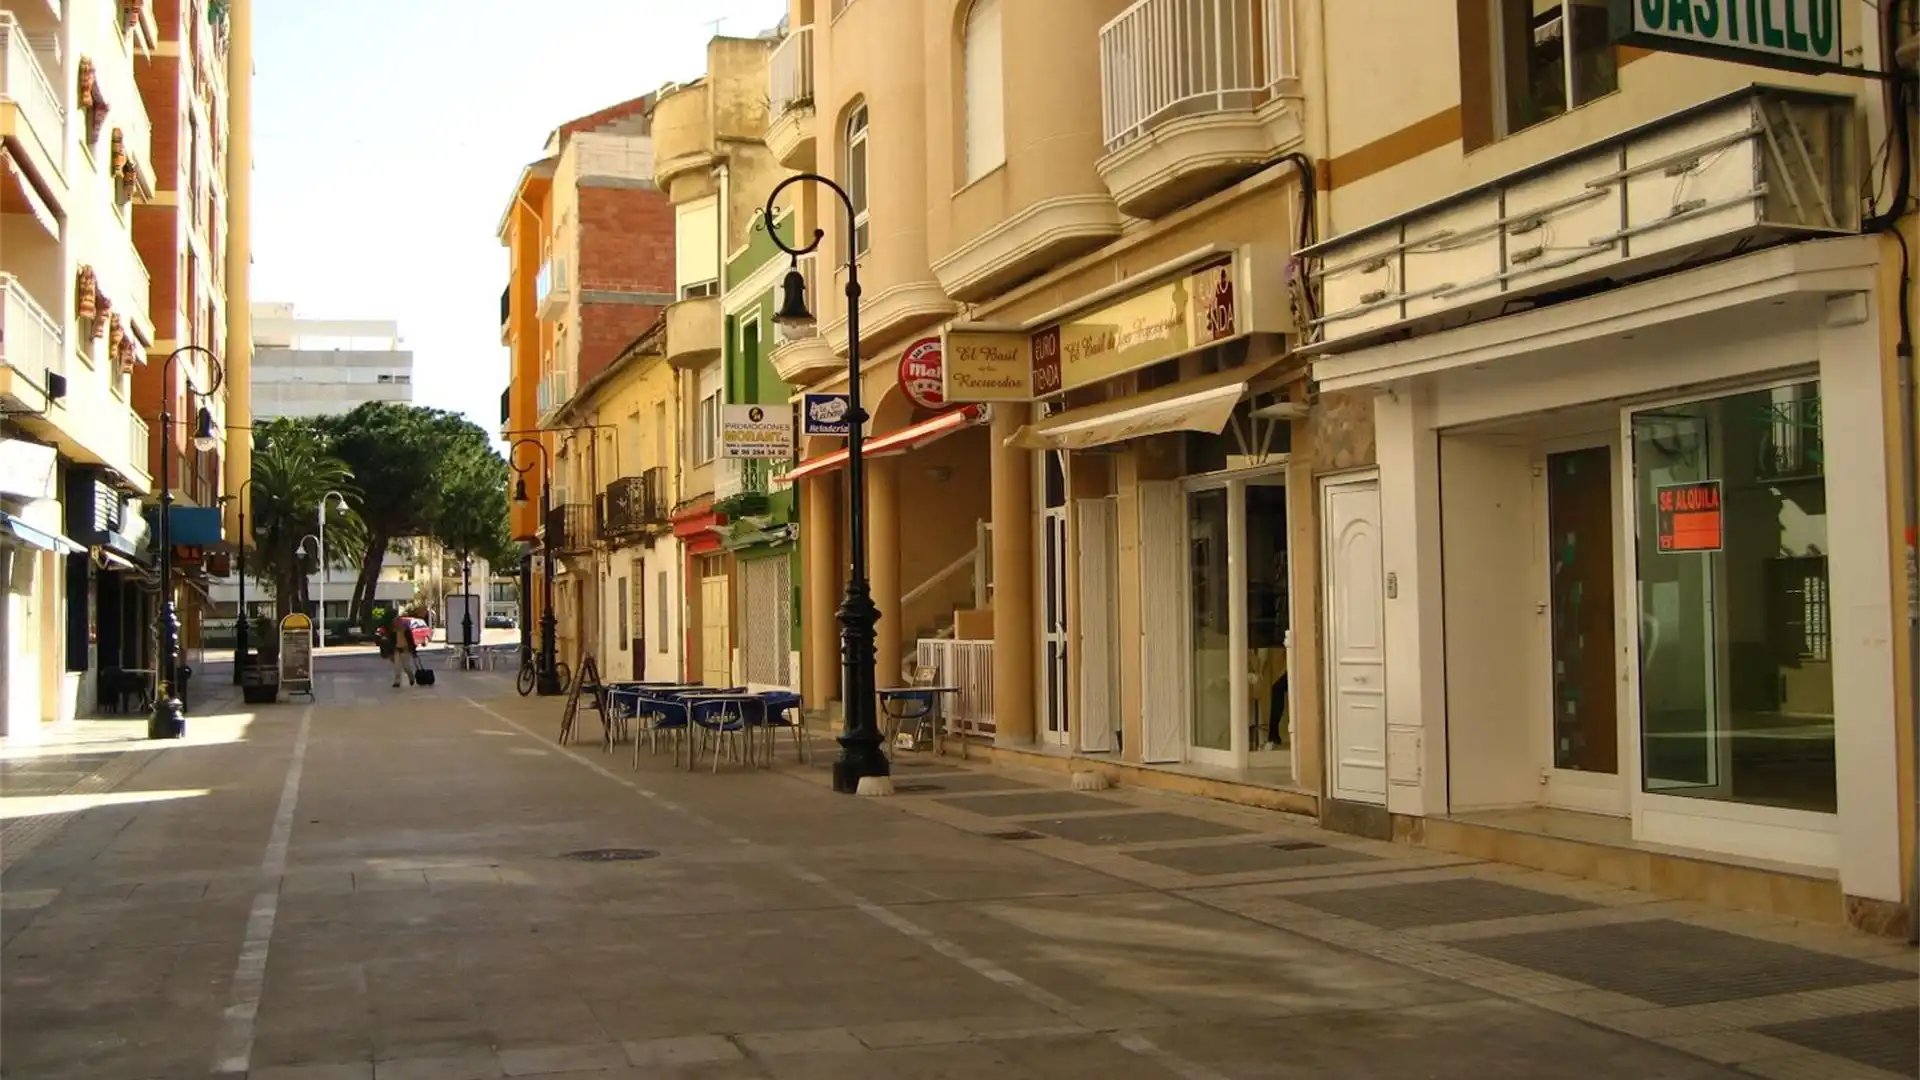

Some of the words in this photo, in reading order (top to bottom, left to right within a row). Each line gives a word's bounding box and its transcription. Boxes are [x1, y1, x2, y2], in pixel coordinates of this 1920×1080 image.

[956, 346, 976, 361] El
[1035, 333, 1056, 361] EURO
[953, 372, 1023, 388] Recuerdos
[1032, 363, 1060, 390] TIENDA
[725, 423, 790, 431] PROMOCIONES
[725, 431, 783, 442] MORANT
[1660, 491, 1673, 511] SE
[1675, 487, 1720, 511] ALQUILA
